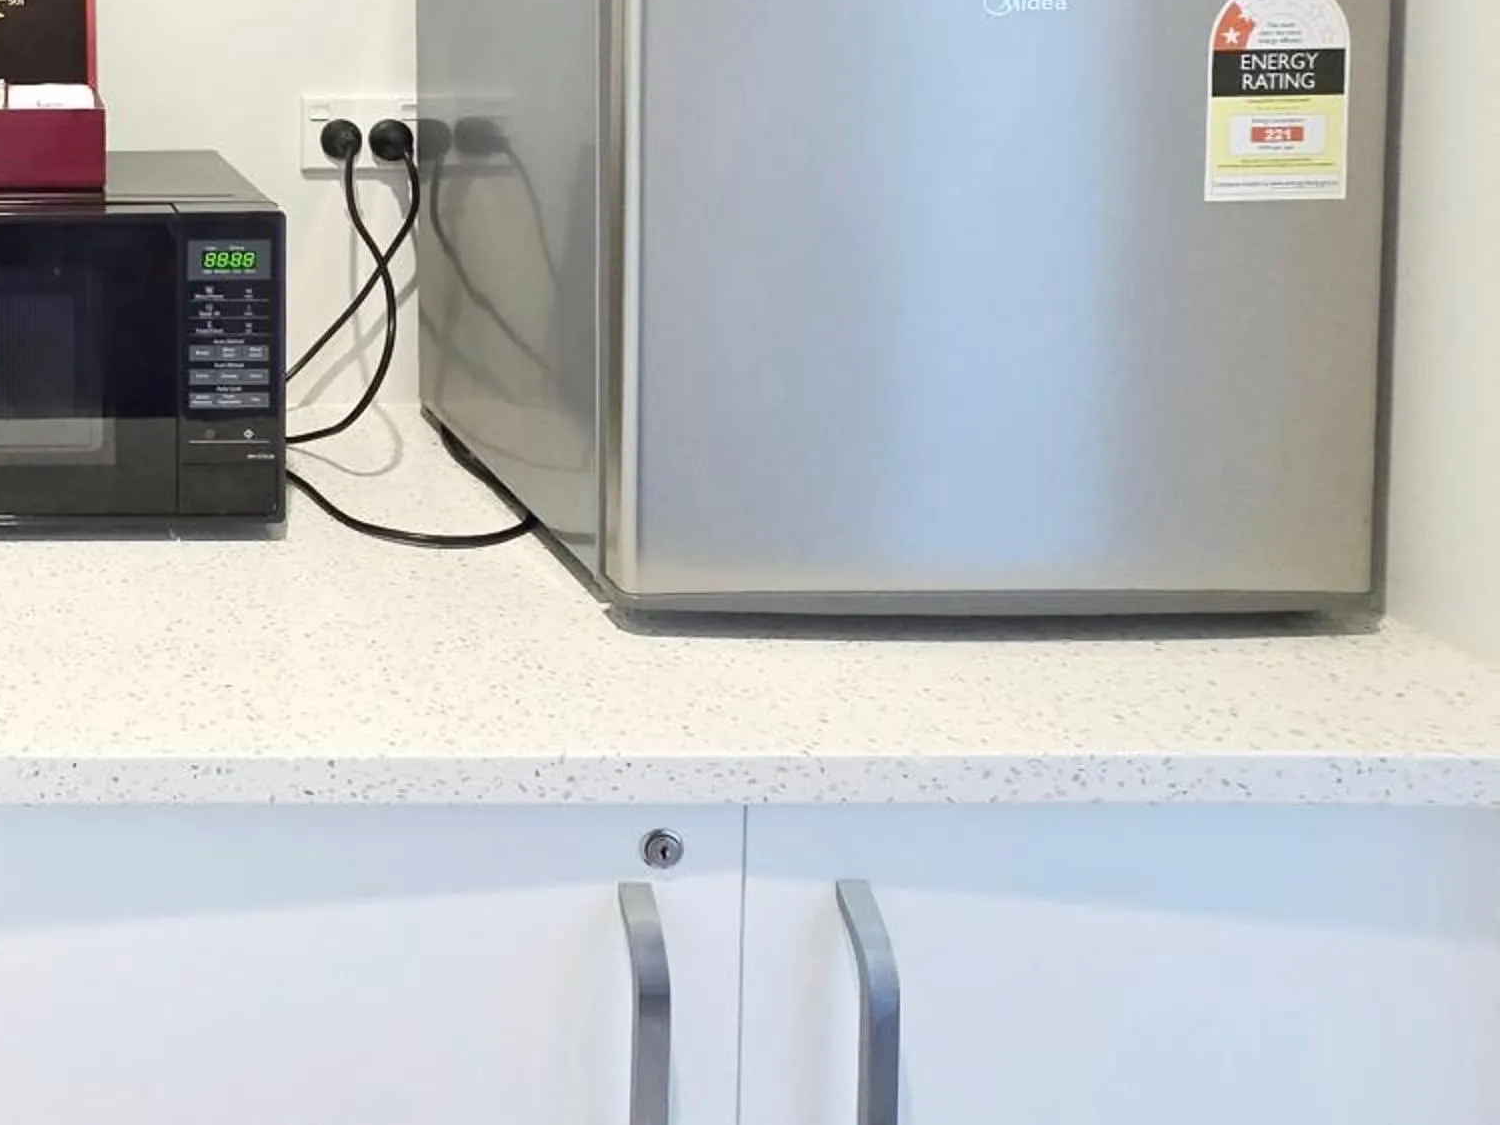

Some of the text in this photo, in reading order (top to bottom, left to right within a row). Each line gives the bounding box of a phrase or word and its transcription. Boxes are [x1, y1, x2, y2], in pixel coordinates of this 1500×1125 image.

[1240, 52, 1319, 71] ENERGY
[1241, 72, 1316, 91] RATING
[1264, 128, 1292, 141] 221
